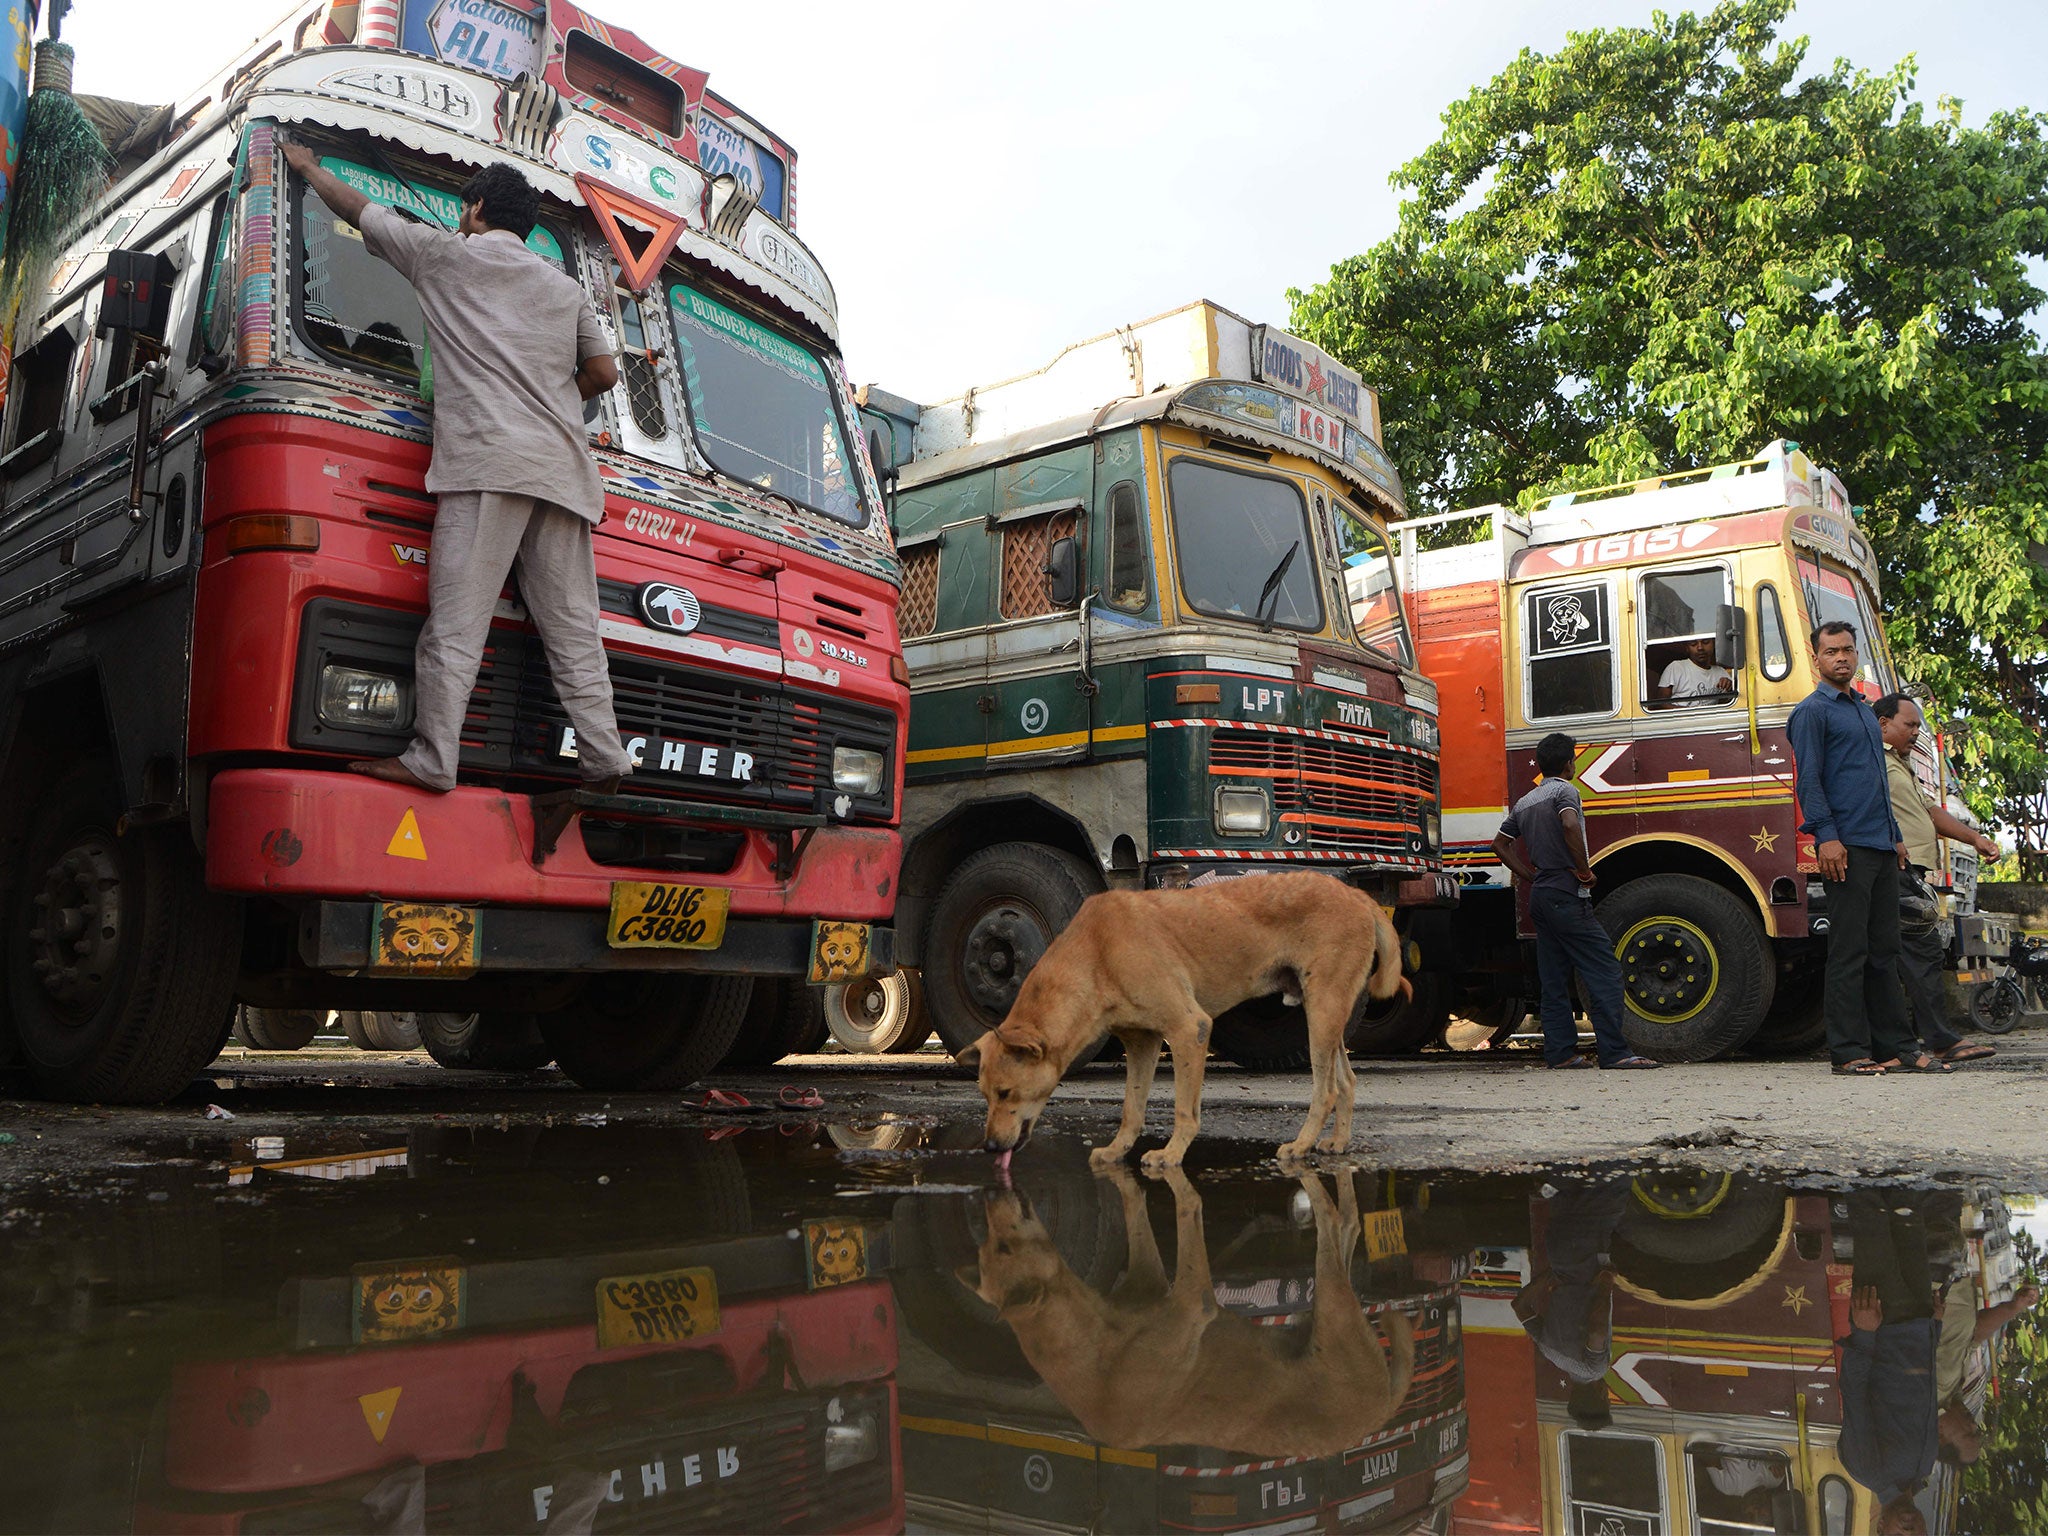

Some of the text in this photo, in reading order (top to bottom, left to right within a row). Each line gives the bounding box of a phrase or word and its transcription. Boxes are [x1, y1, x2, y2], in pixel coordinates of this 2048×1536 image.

[443, 20, 512, 75] ALL
[699, 116, 746, 158] ermit
[340, 165, 369, 184] LABOUR
[348, 177, 364, 191] JOB
[585, 134, 677, 201] SRC
[700, 141, 753, 187] NDIA
[368, 174, 460, 222] SHARMA
[690, 294, 750, 342] BUILDER
[1265, 338, 1303, 390] GOODS
[1300, 407, 1340, 452] KGN
[625, 507, 697, 547] GURU JI
[394, 543, 427, 565] VE
[820, 640, 857, 666] 30.25
[1243, 686, 1285, 714] LPT
[1337, 701, 1374, 728] TATA
[1410, 718, 1431, 744] 1612
[559, 727, 753, 781] ECHER
